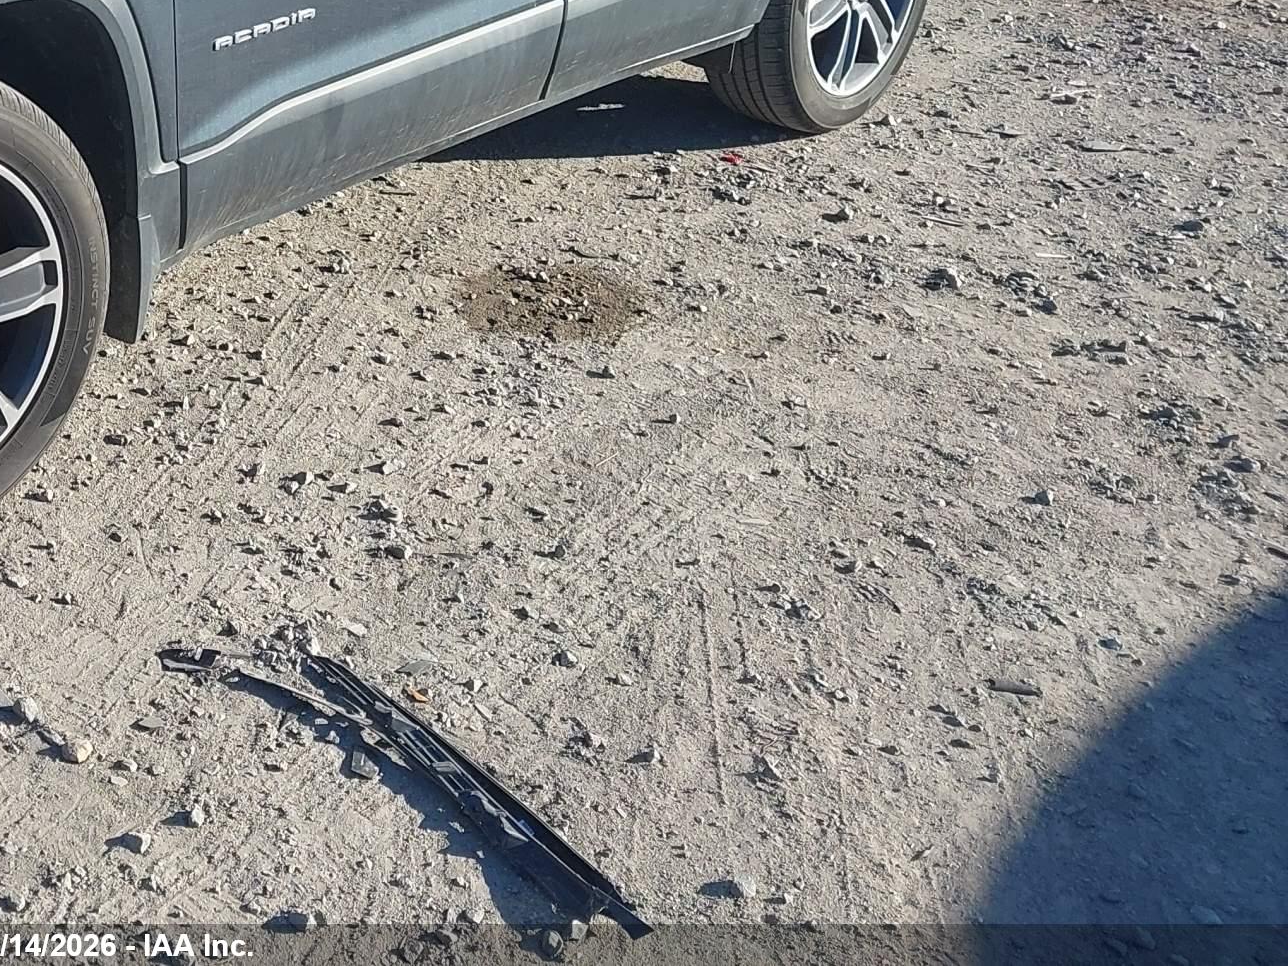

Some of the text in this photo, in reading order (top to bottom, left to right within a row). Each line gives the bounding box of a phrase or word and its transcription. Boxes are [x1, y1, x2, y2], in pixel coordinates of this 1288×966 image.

[212, 7, 316, 51] ACADIA
[82, 236, 100, 355] INSTINCT SUV
